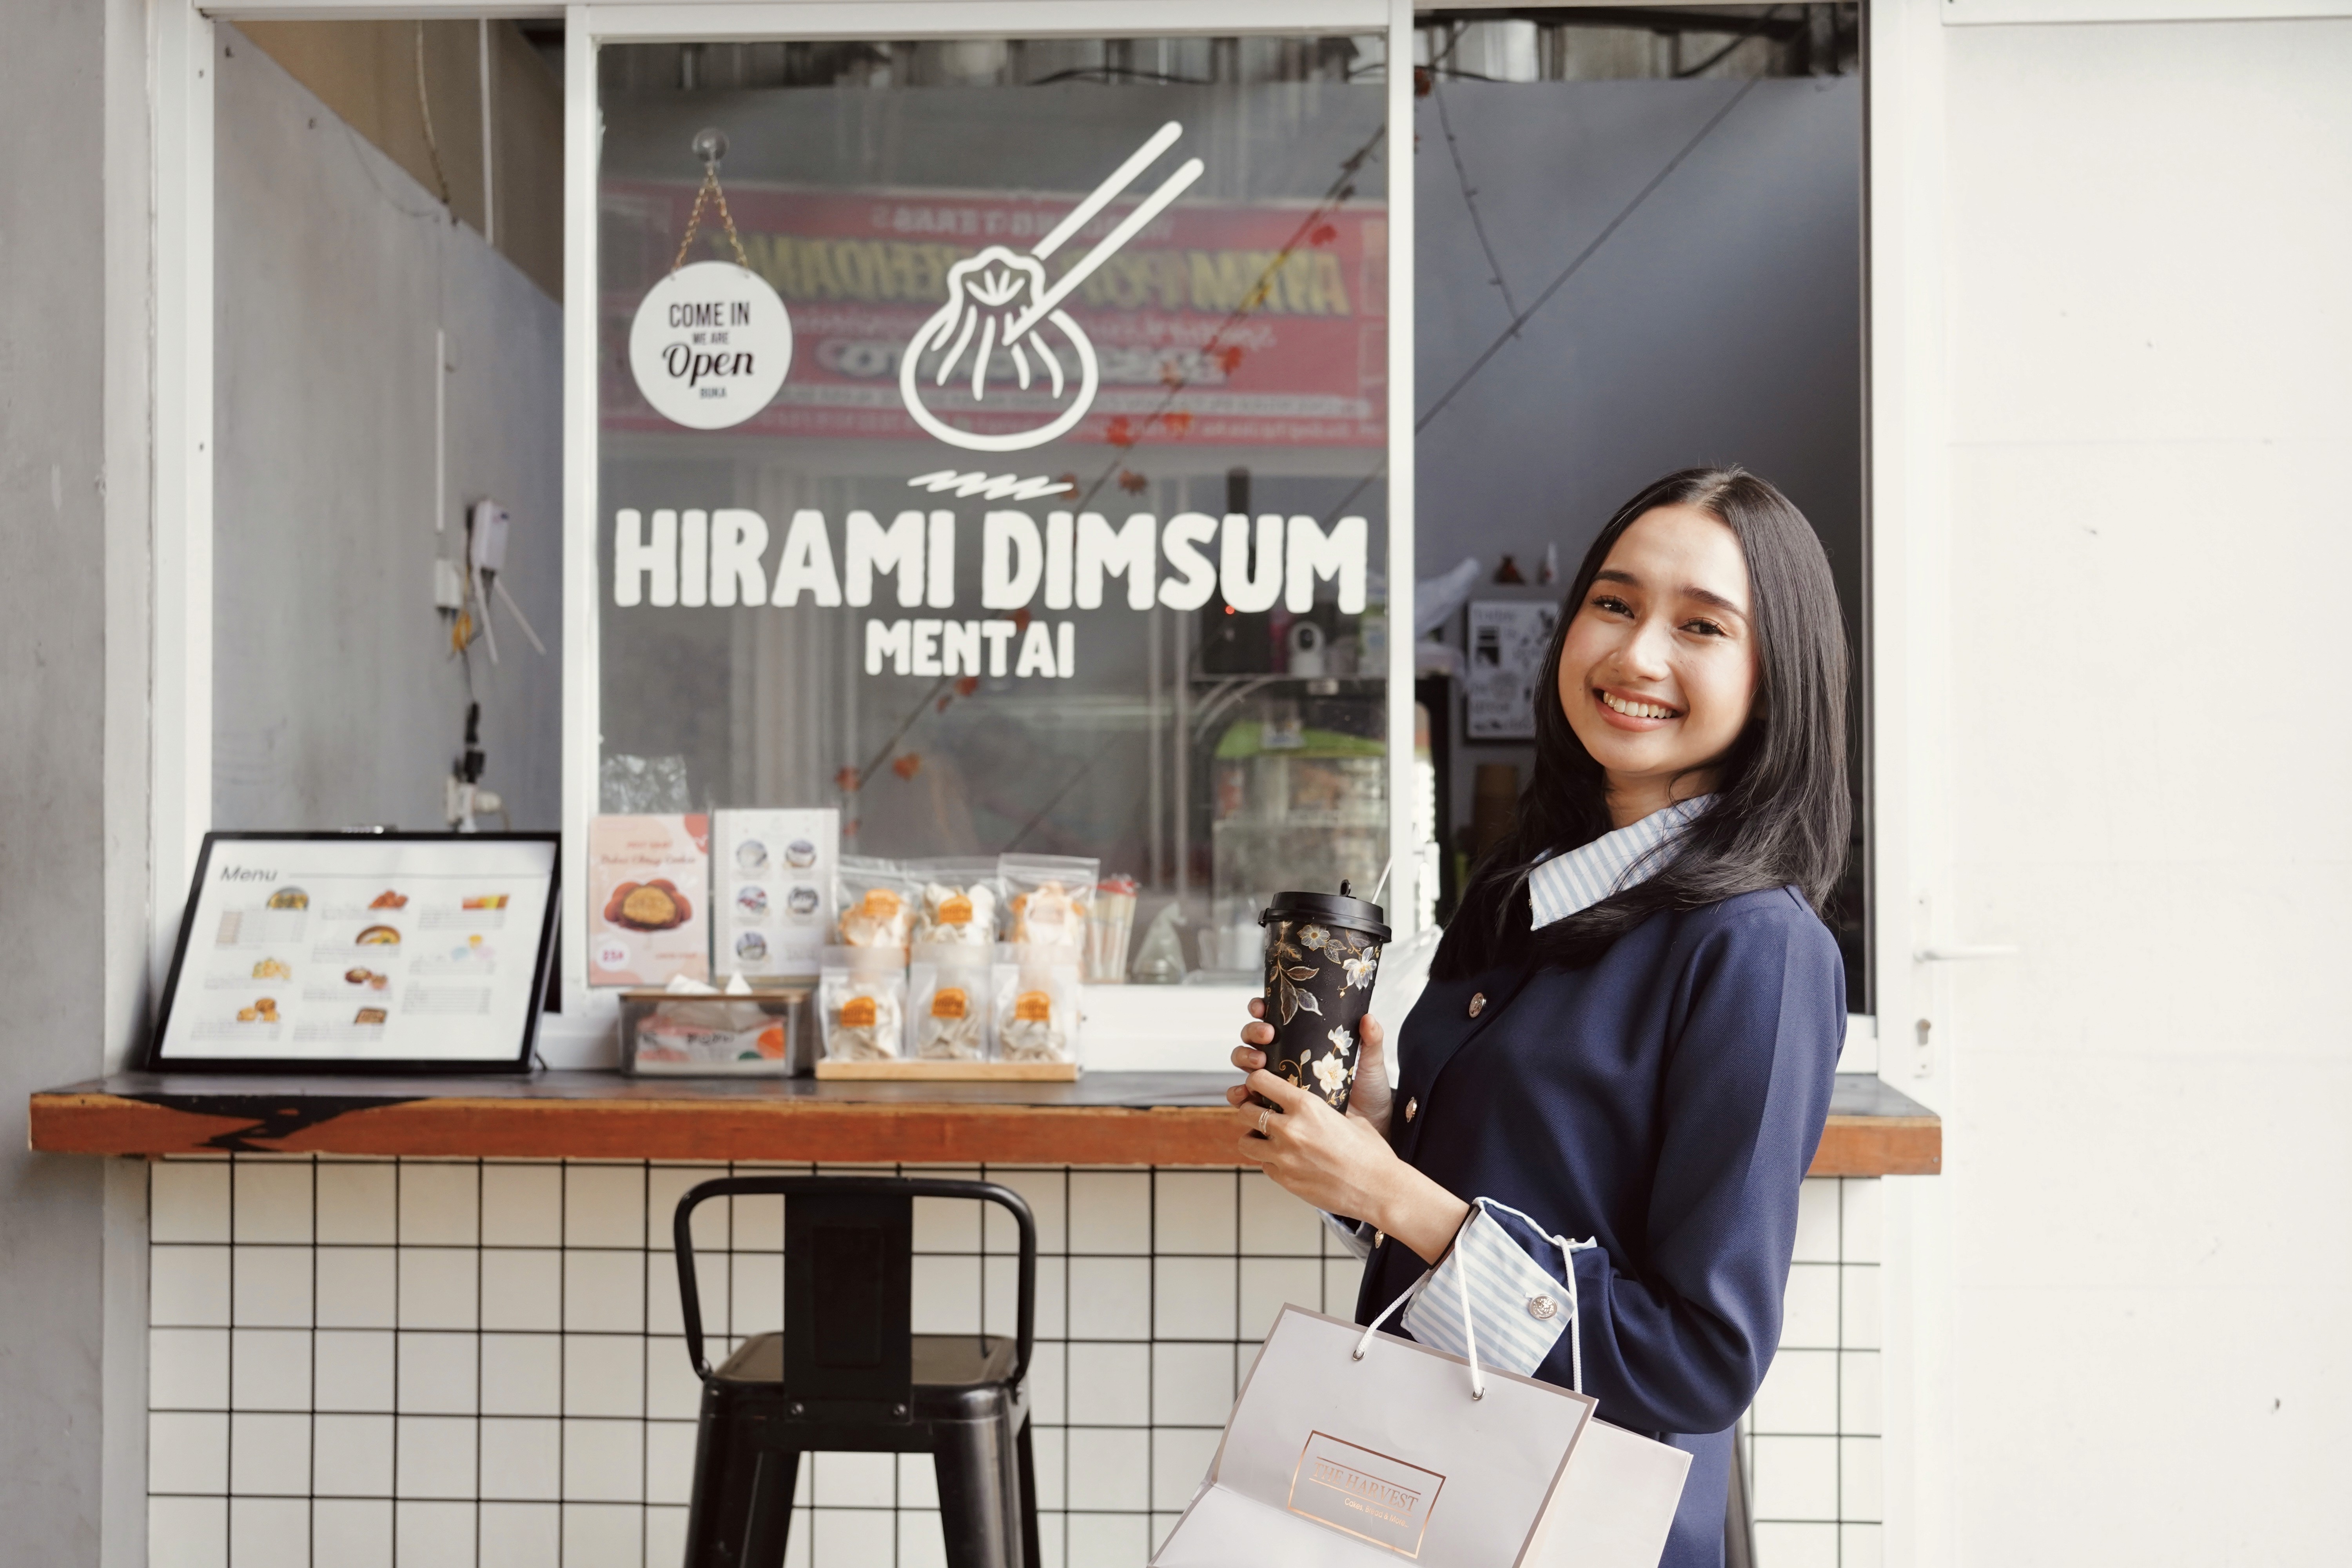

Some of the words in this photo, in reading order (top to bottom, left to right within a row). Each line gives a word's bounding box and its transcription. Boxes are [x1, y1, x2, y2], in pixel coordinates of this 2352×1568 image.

[669, 302, 725, 328] COME
[731, 301, 750, 326] IN
[693, 332, 706, 345] WE
[711, 332, 729, 344] ARE
[662, 343, 754, 388] Open
[701, 388, 727, 398] BUKA
[616, 510, 955, 607] HIRAMI
[983, 511, 1367, 613] DIMSUM
[866, 620, 1074, 677] MENTAI
[220, 865, 278, 882] Menu
[1314, 1461, 1343, 1485] THE
[1345, 1474, 1419, 1512] HARVEST
[1345, 1497, 1363, 1512] Cakes,
[1365, 1505, 1383, 1518] Bread
[1389, 1514, 1409, 1528] More...
